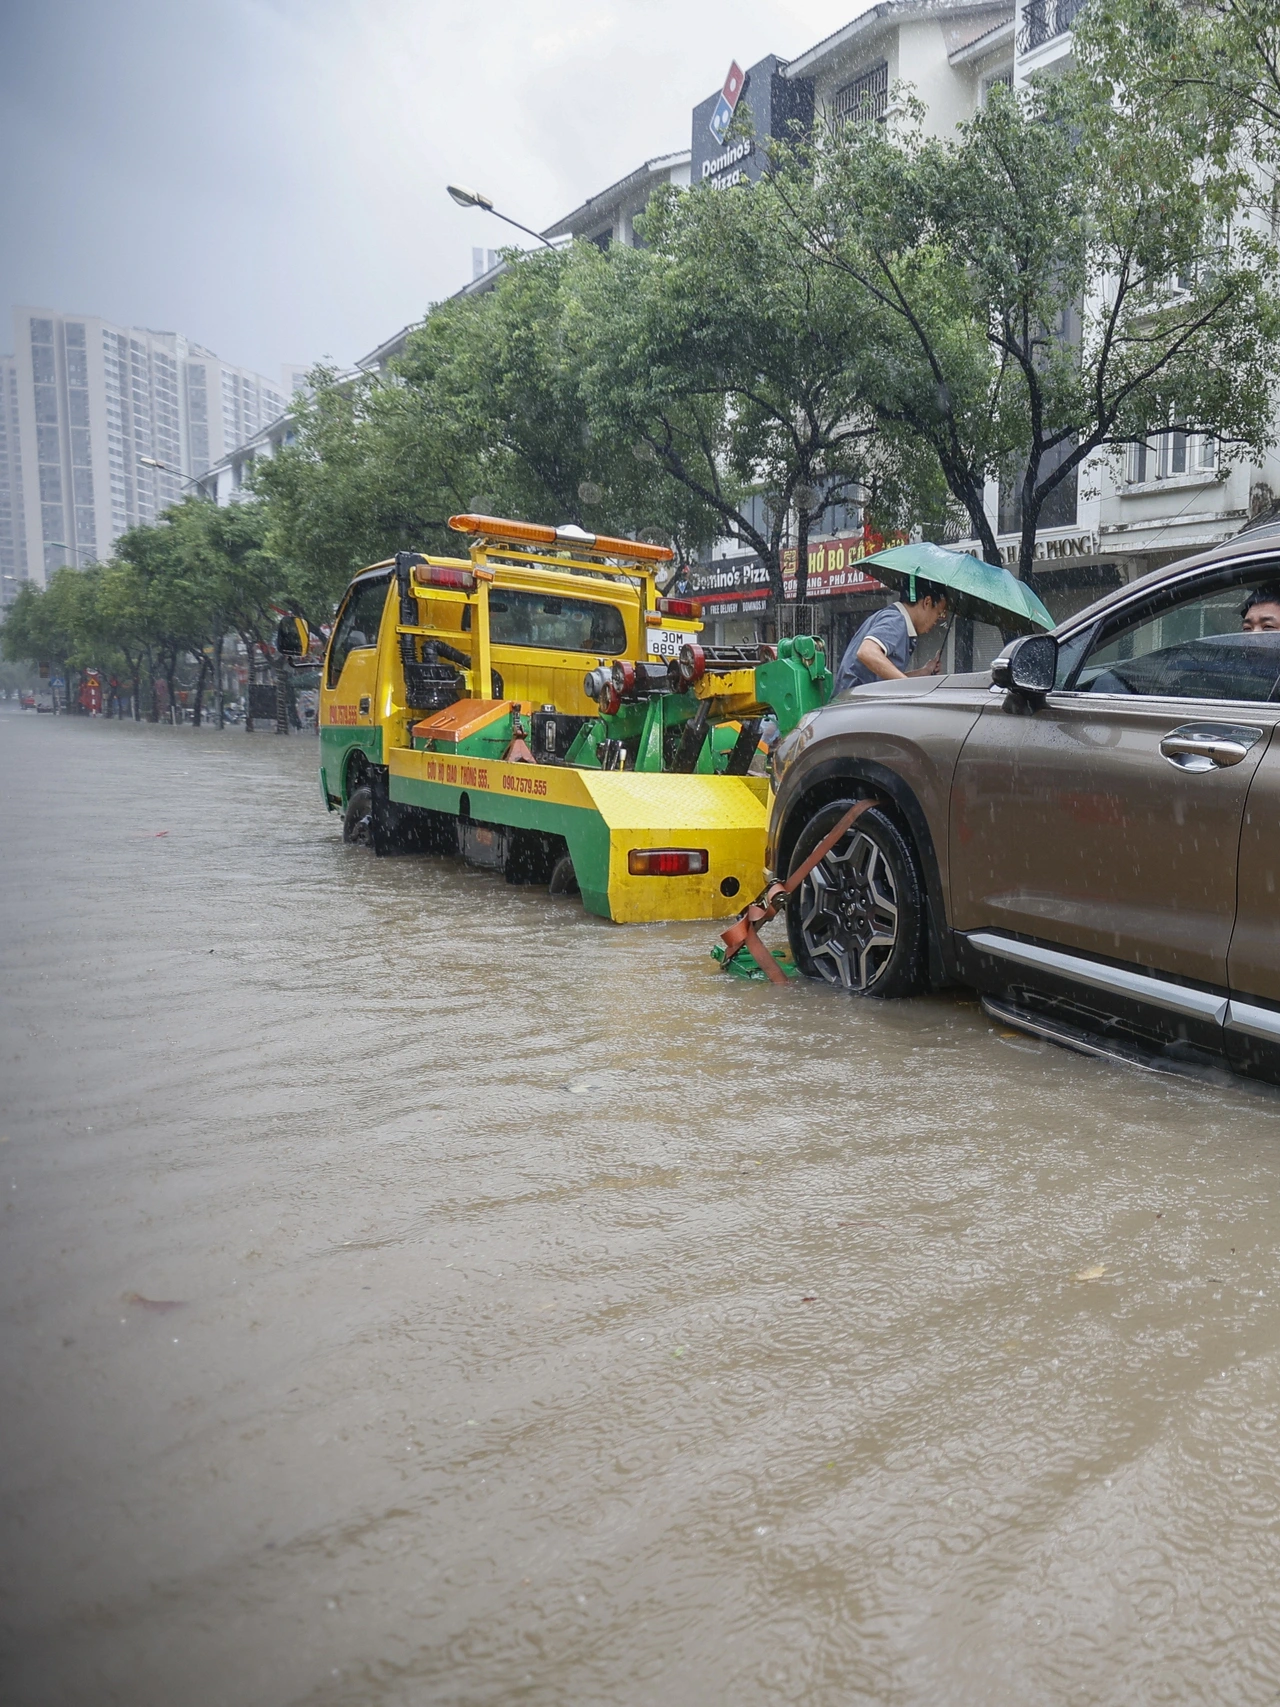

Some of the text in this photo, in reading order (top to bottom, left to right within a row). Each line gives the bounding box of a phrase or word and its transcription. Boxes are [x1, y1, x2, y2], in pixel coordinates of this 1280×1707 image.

[702, 136, 751, 178] Domino's
[808, 545, 825, 574] HỞ
[827, 543, 844, 571] BÒ
[1046, 535, 1092, 559] PHONG
[692, 566, 740, 591] Domino's
[806, 576, 822, 589] ANG
[829, 572, 845, 585] PHỞ
[847, 570, 864, 584] XÀO
[710, 604, 720, 615] FREE
[720, 602, 738, 614] DELIVERY
[661, 631, 683, 645] 30M
[502, 774, 547, 796] 090.7579.555
